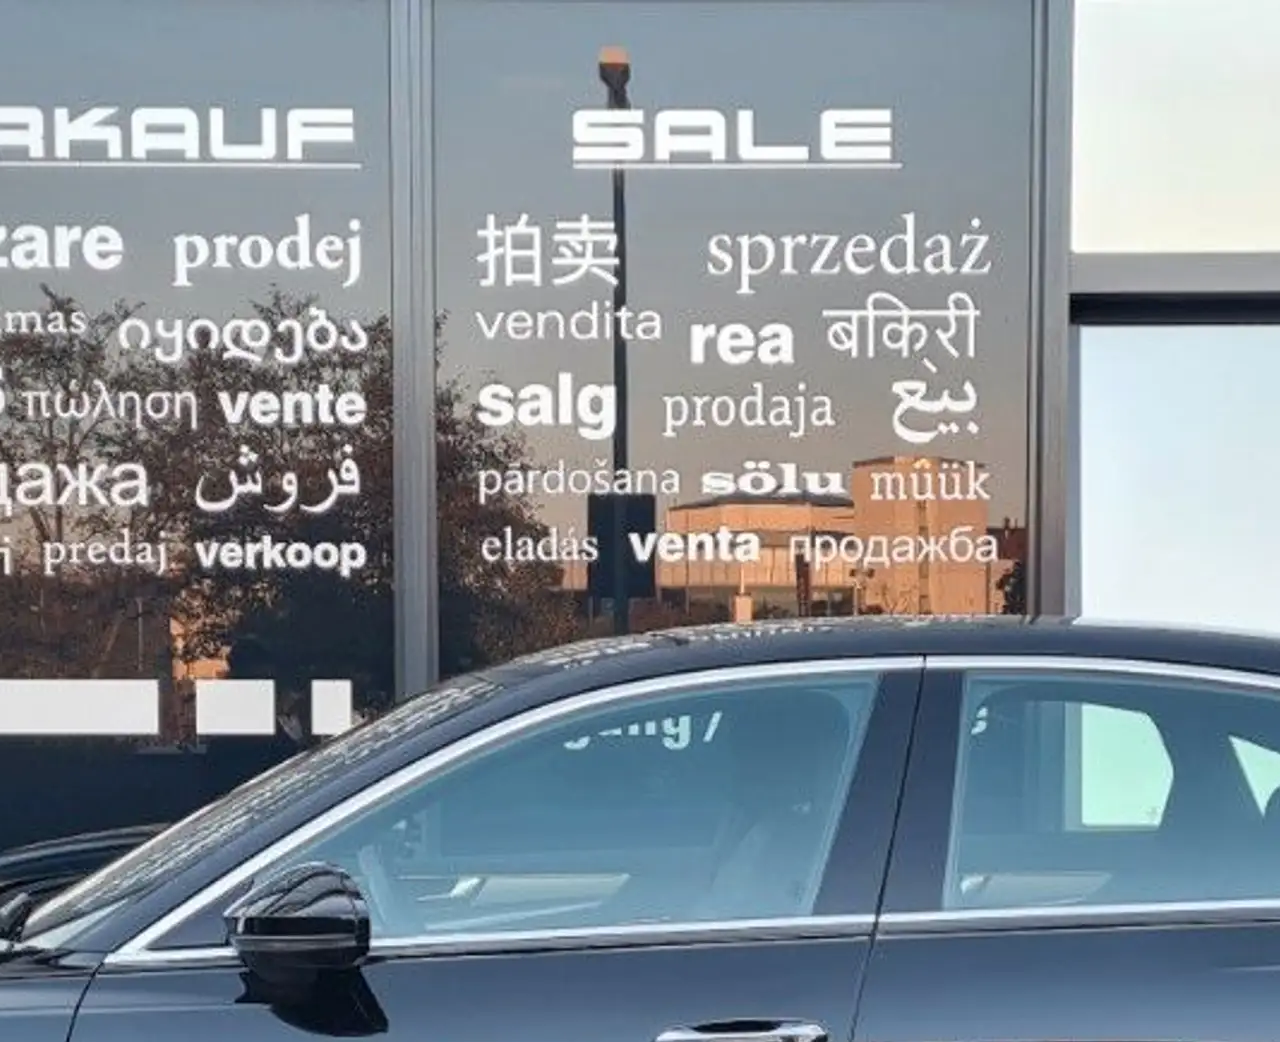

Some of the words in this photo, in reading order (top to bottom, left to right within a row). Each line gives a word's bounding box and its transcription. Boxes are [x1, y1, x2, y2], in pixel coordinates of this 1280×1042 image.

[572, 109, 891, 161] SALE
[172, 213, 361, 288] prodej
[476, 213, 619, 287] 拍卖
[707, 212, 992, 295] sprzedaż
[118, 306, 368, 364] იყიდება
[475, 300, 661, 340] vendita
[690, 323, 794, 365] rea
[21, 378, 197, 431] πώληση
[218, 383, 367, 425] vente
[477, 372, 615, 440] salg
[662, 382, 835, 438] prodaja
[195, 442, 360, 513] فروش
[479, 458, 680, 503] pārdošana
[701, 460, 846, 495] sölu
[43, 527, 167, 576] predaj
[194, 534, 367, 578] verkoop
[481, 525, 598, 562] eladás
[629, 526, 760, 563] venta
[789, 525, 998, 569] продажба
